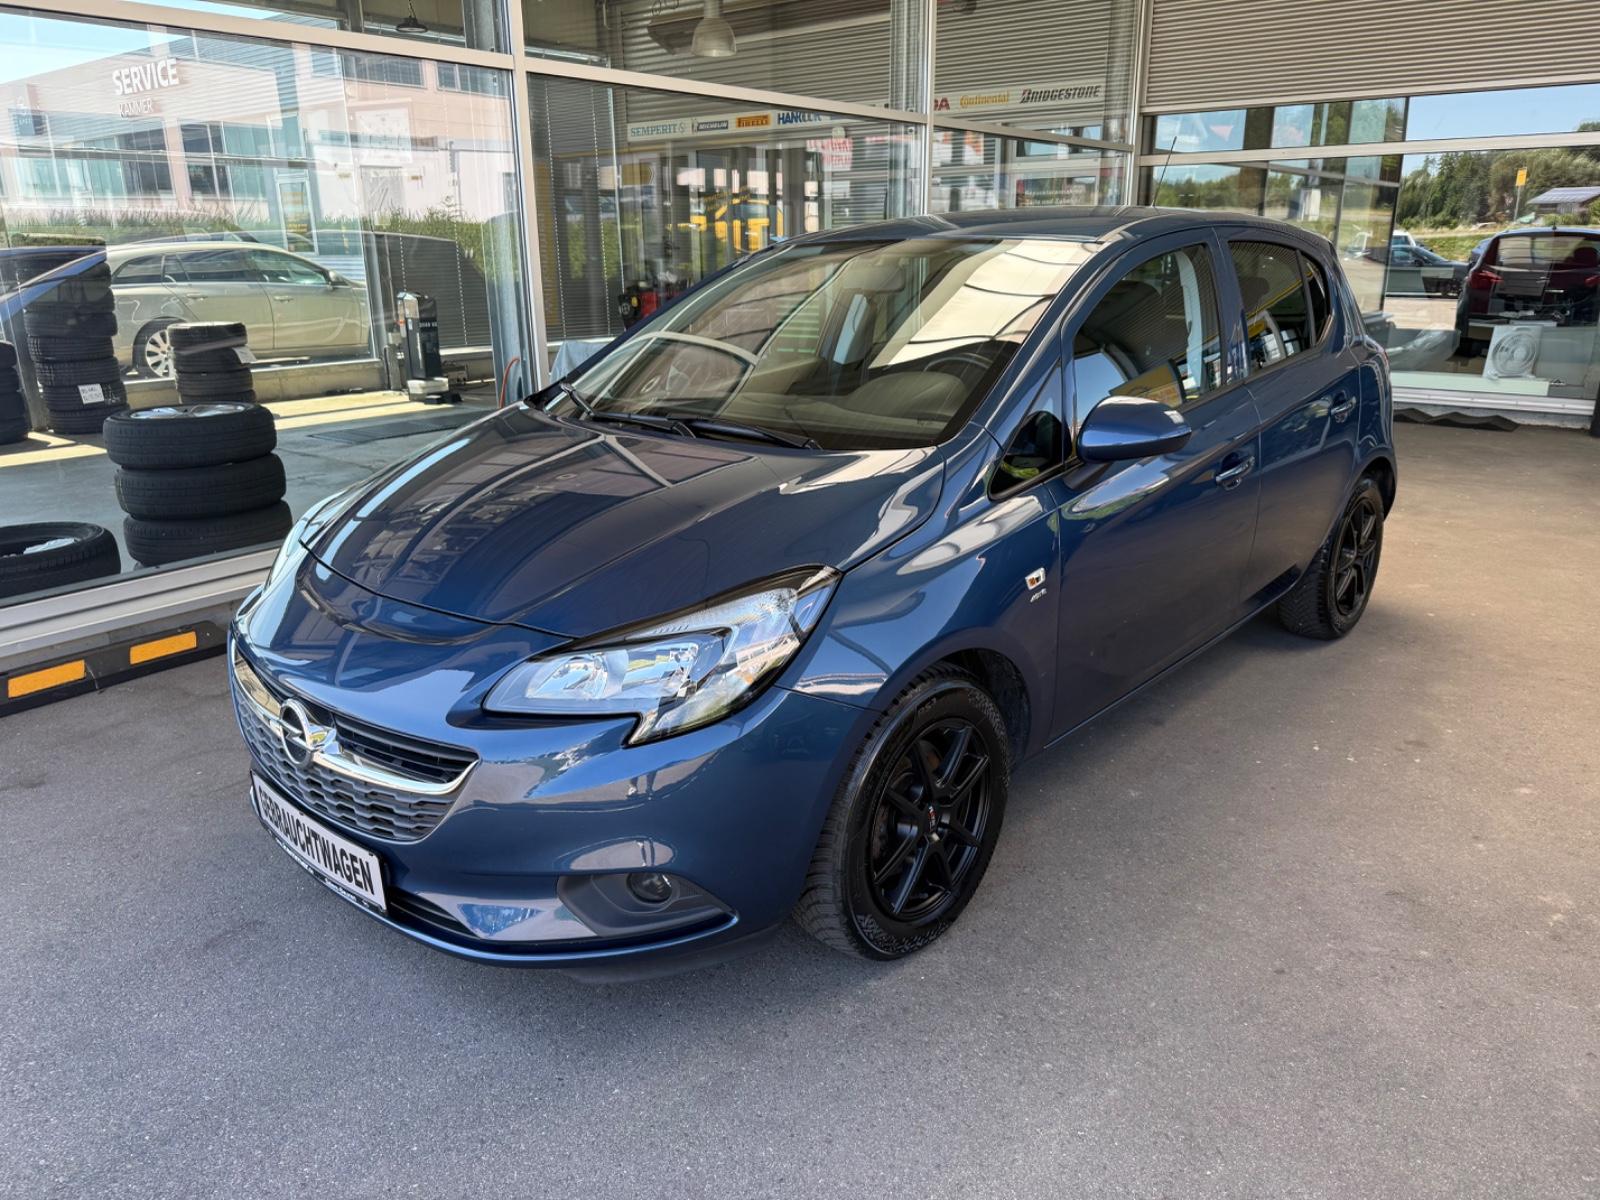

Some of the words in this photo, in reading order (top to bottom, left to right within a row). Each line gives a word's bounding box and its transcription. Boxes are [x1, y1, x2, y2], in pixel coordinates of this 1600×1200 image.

[112, 58, 179, 95] SERVICE
[960, 92, 1009, 108] Continental
[1020, 85, 1101, 104] BRIDGESTONE
[630, 123, 677, 137] SEMPERIT
[698, 121, 728, 131] MICHELIN
[258, 786, 375, 896] GEBRAUCHTWAGEN
